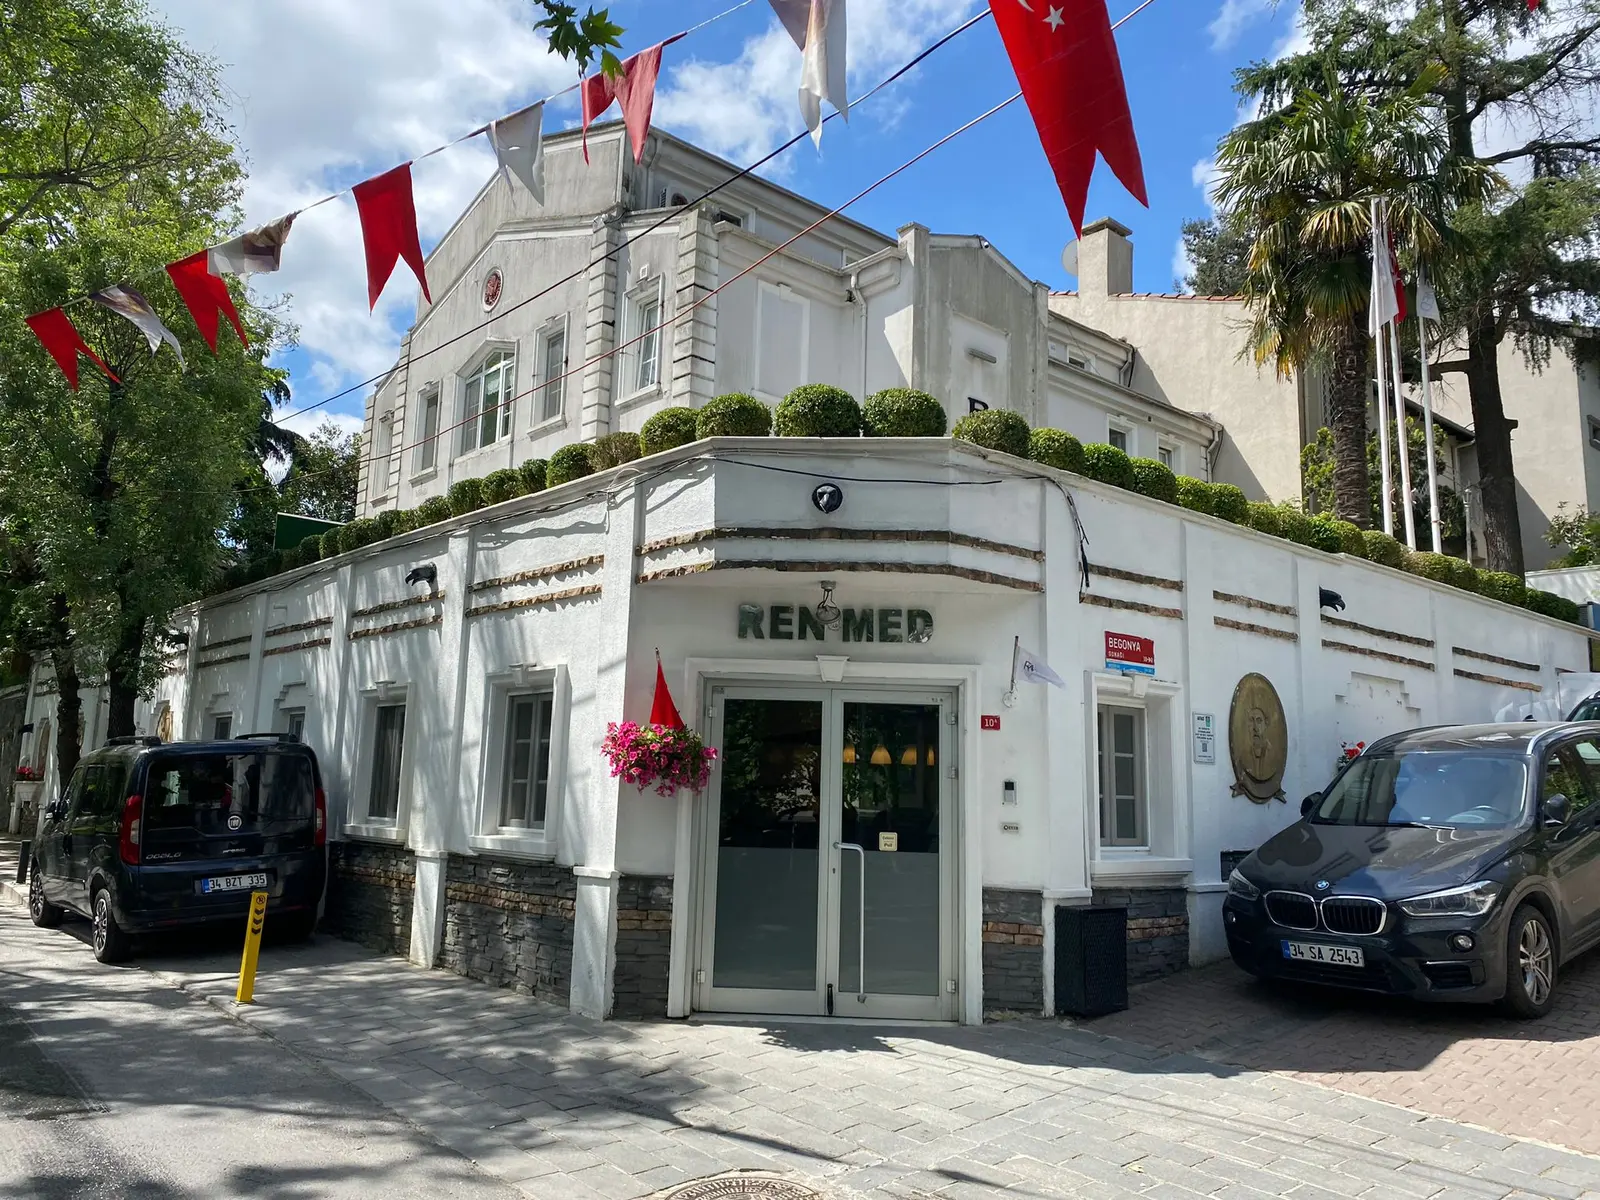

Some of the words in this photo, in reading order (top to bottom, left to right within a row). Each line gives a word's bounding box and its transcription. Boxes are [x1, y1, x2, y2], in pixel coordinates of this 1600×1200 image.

[738, 604, 825, 641] REN
[842, 608, 934, 643] MED
[1108, 637, 1141, 652] BEGONYA
[209, 879, 222, 888] 34
[225, 876, 242, 887] BZT
[248, 874, 266, 885] 335
[1290, 944, 1304, 957] 34
[1309, 946, 1324, 961] SA
[1329, 948, 1360, 964] 2543
